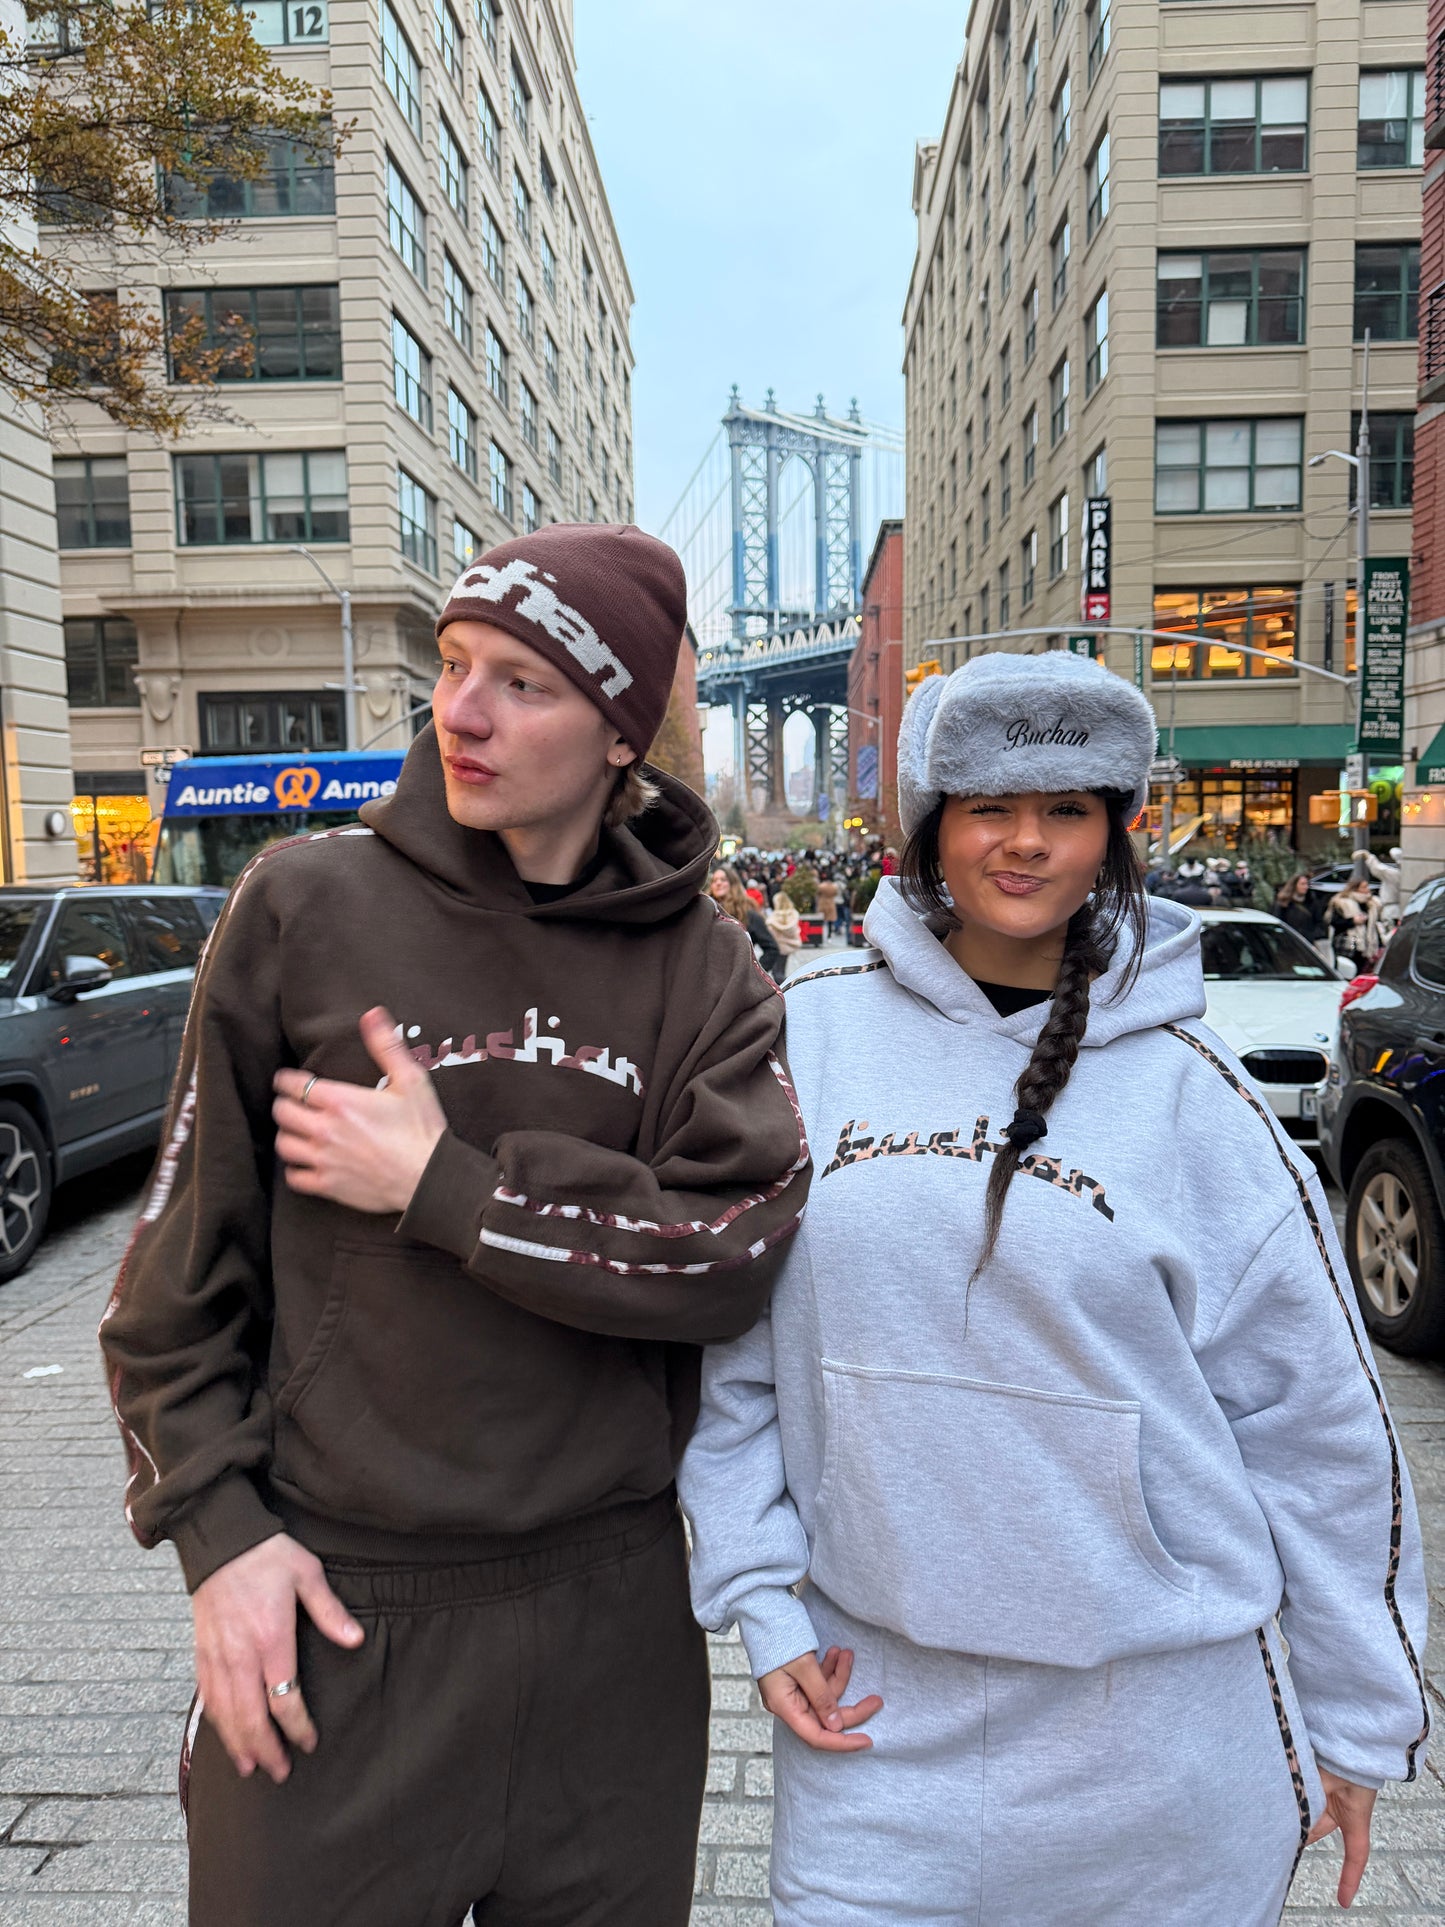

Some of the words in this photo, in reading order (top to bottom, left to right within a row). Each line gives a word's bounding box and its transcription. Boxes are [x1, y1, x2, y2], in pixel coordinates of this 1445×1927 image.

[293, 5, 324, 37] 12
[1090, 510, 1108, 588] PARK
[1368, 589, 1404, 602] PIZZA
[1370, 617, 1401, 626] LUNCH
[1381, 625, 1389, 634] &
[1368, 633, 1402, 642] DINNER
[1003, 717, 1090, 752] Buchan
[176, 782, 270, 807] Auntie
